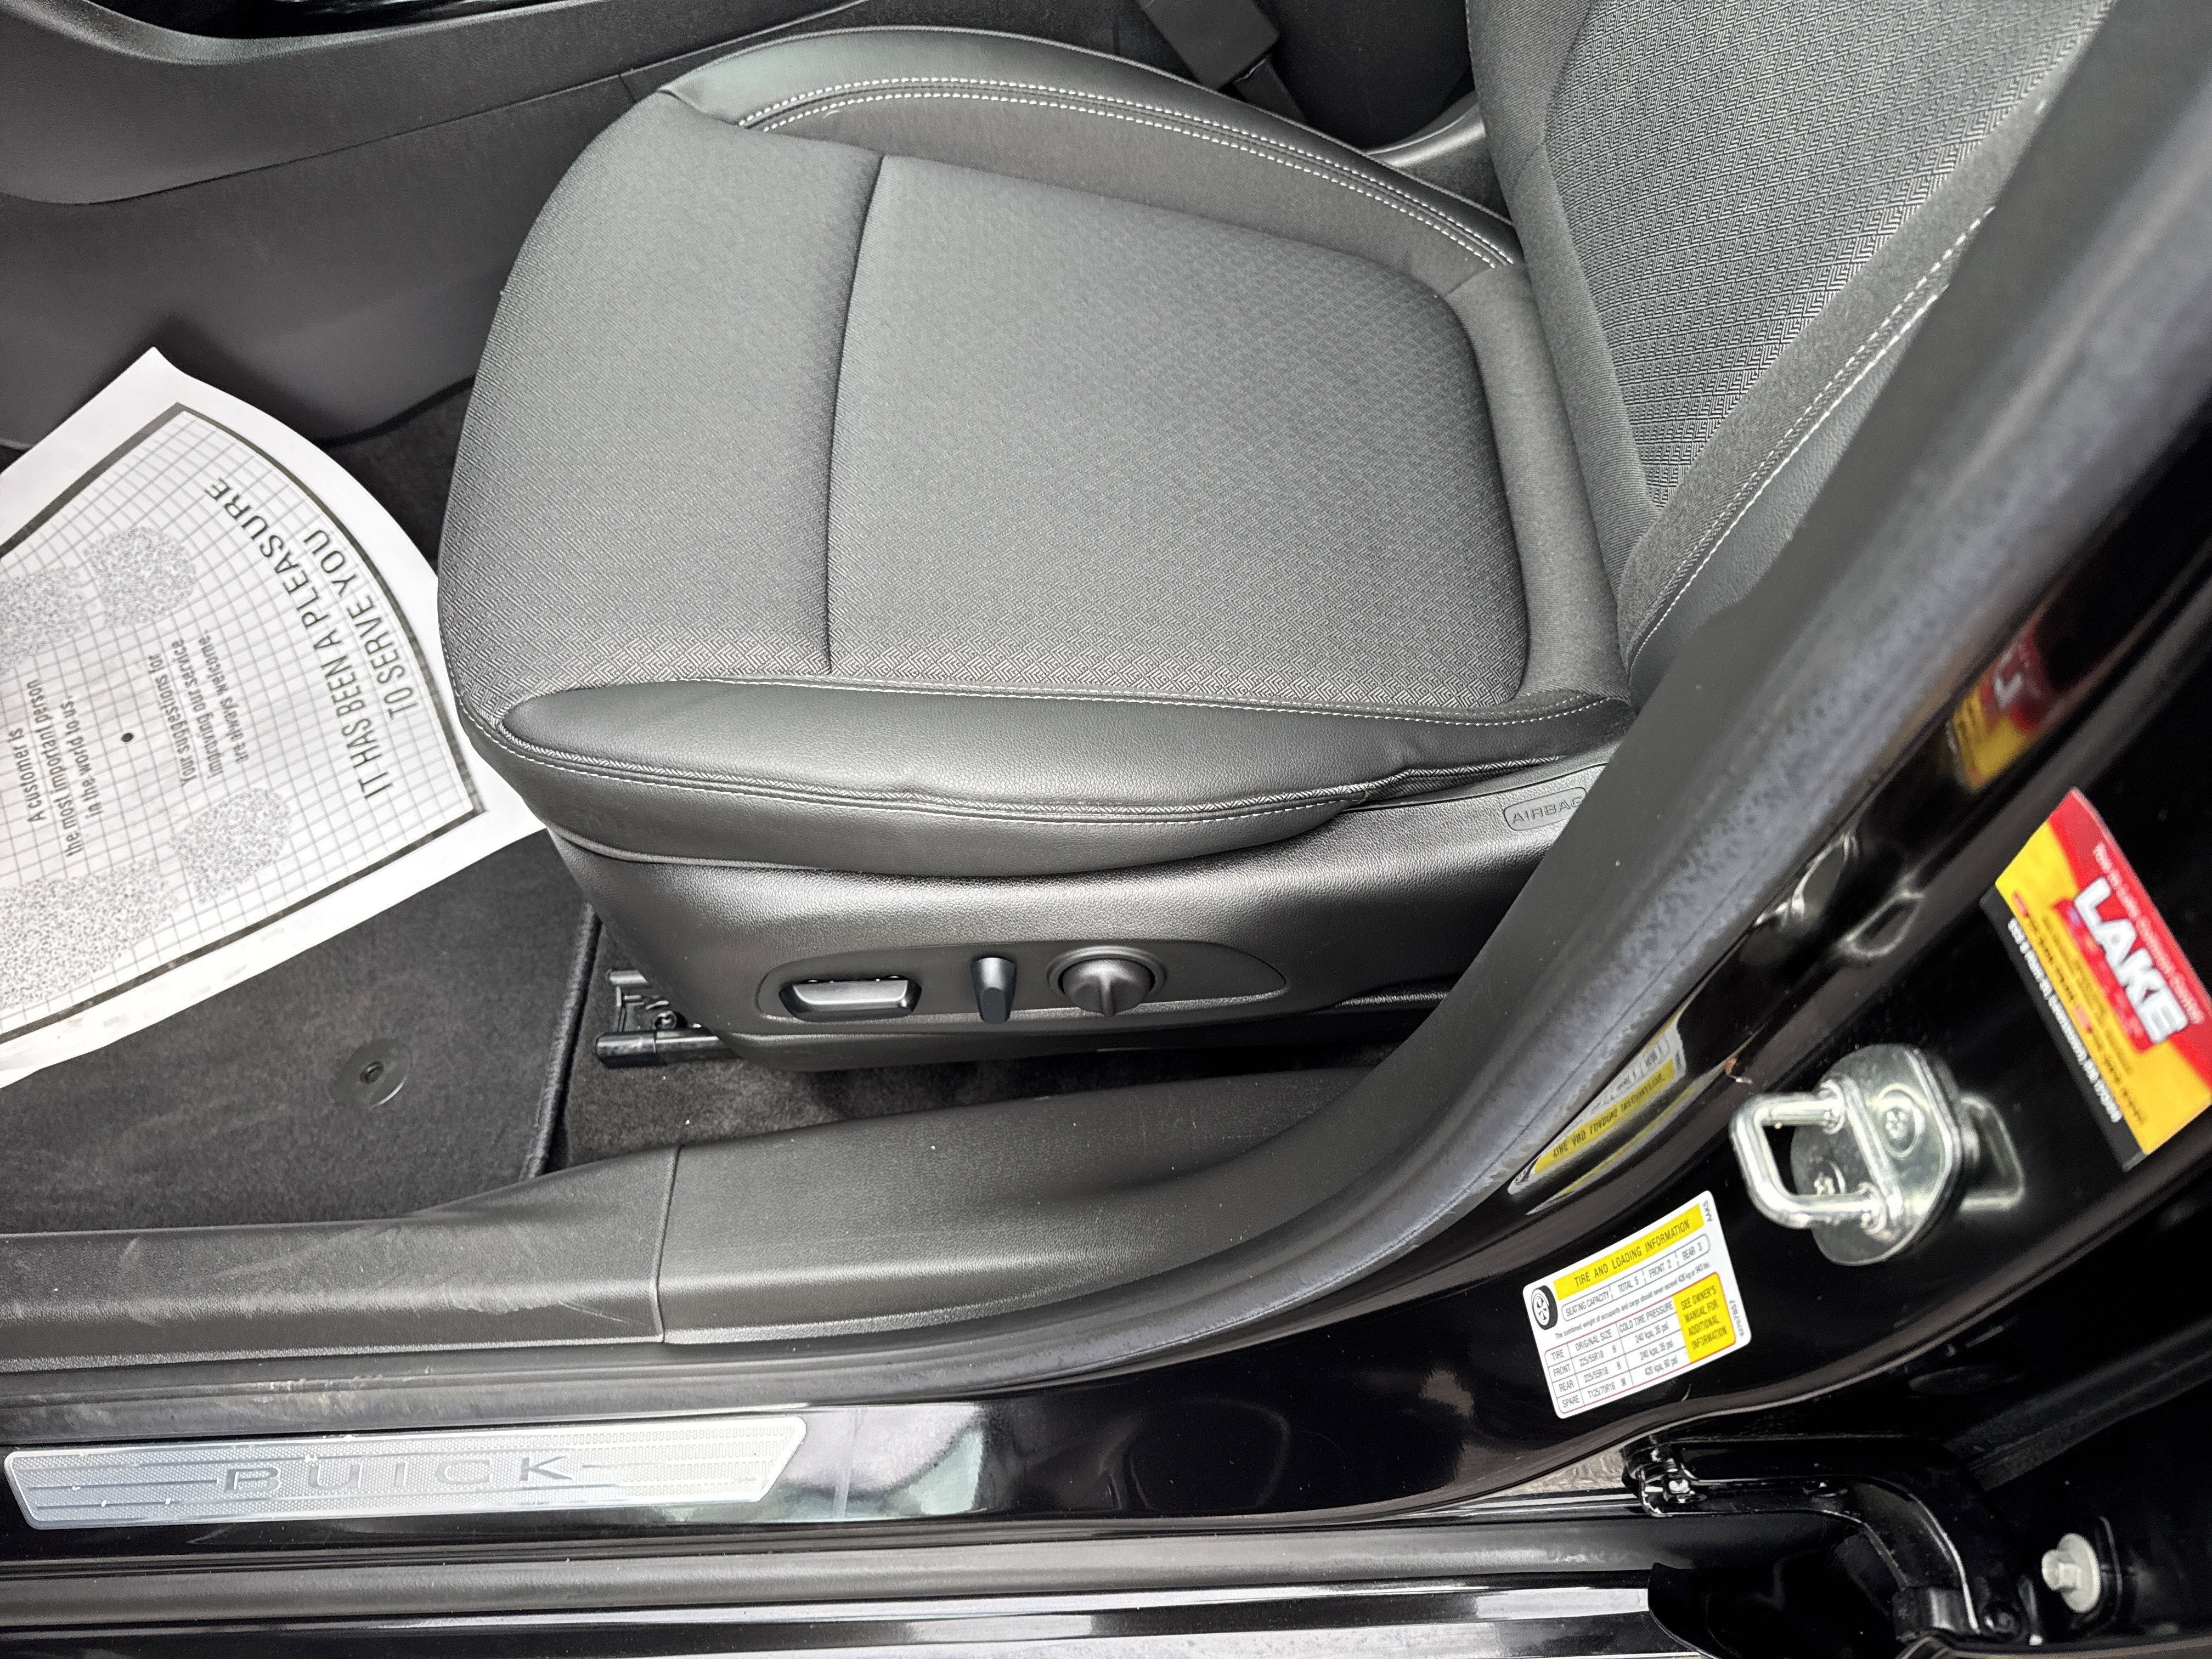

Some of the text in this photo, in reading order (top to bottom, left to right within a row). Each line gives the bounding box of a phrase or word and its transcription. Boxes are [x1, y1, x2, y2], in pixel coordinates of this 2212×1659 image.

[303, 529, 420, 721] TO SERVE YOU
[204, 476, 394, 800] IT HAS BEEN A PLEASURE
[172, 638, 198, 687] service
[188, 689, 207, 713] our
[65, 720, 80, 736] to
[148, 653, 198, 787] Your suggestions for
[220, 696, 244, 741] always
[66, 736, 91, 777] world
[233, 742, 249, 764] are
[8, 727, 46, 823] A customer is
[27, 679, 83, 857] the most important person
[81, 776, 99, 801] the
[86, 800, 104, 819] in
[1511, 796, 1582, 823] AIRBAG
[2074, 877, 2189, 1044] LAKE
[1573, 1219, 1689, 1286] TIRE AND LOADING INFORMATION
[1681, 1246, 1696, 1260] REAR
[1649, 1259, 1672, 1277] FRONT 2
[1618, 1280, 1632, 1292] TOTAL
[1565, 1290, 1609, 1316] SEATING CAPACITY
[1681, 1297, 1691, 1310] SEE
[1684, 1299, 1718, 1323] MANUAL FOR
[1619, 1301, 1673, 1332] COLD TIRE PRESSURE
[1688, 1315, 1719, 1336] ADDITIONAL
[1575, 1329, 1612, 1351] ORIGINAL SIZE
[1691, 1327, 1726, 1349] INFORMATION
[1551, 1349, 1564, 1360] TIRE
[1553, 1363, 1571, 1376] FRONT
[1559, 1379, 1574, 1392] REAR
[1562, 1395, 1579, 1408] SPARE
[223, 1456, 573, 1493] BUICK
